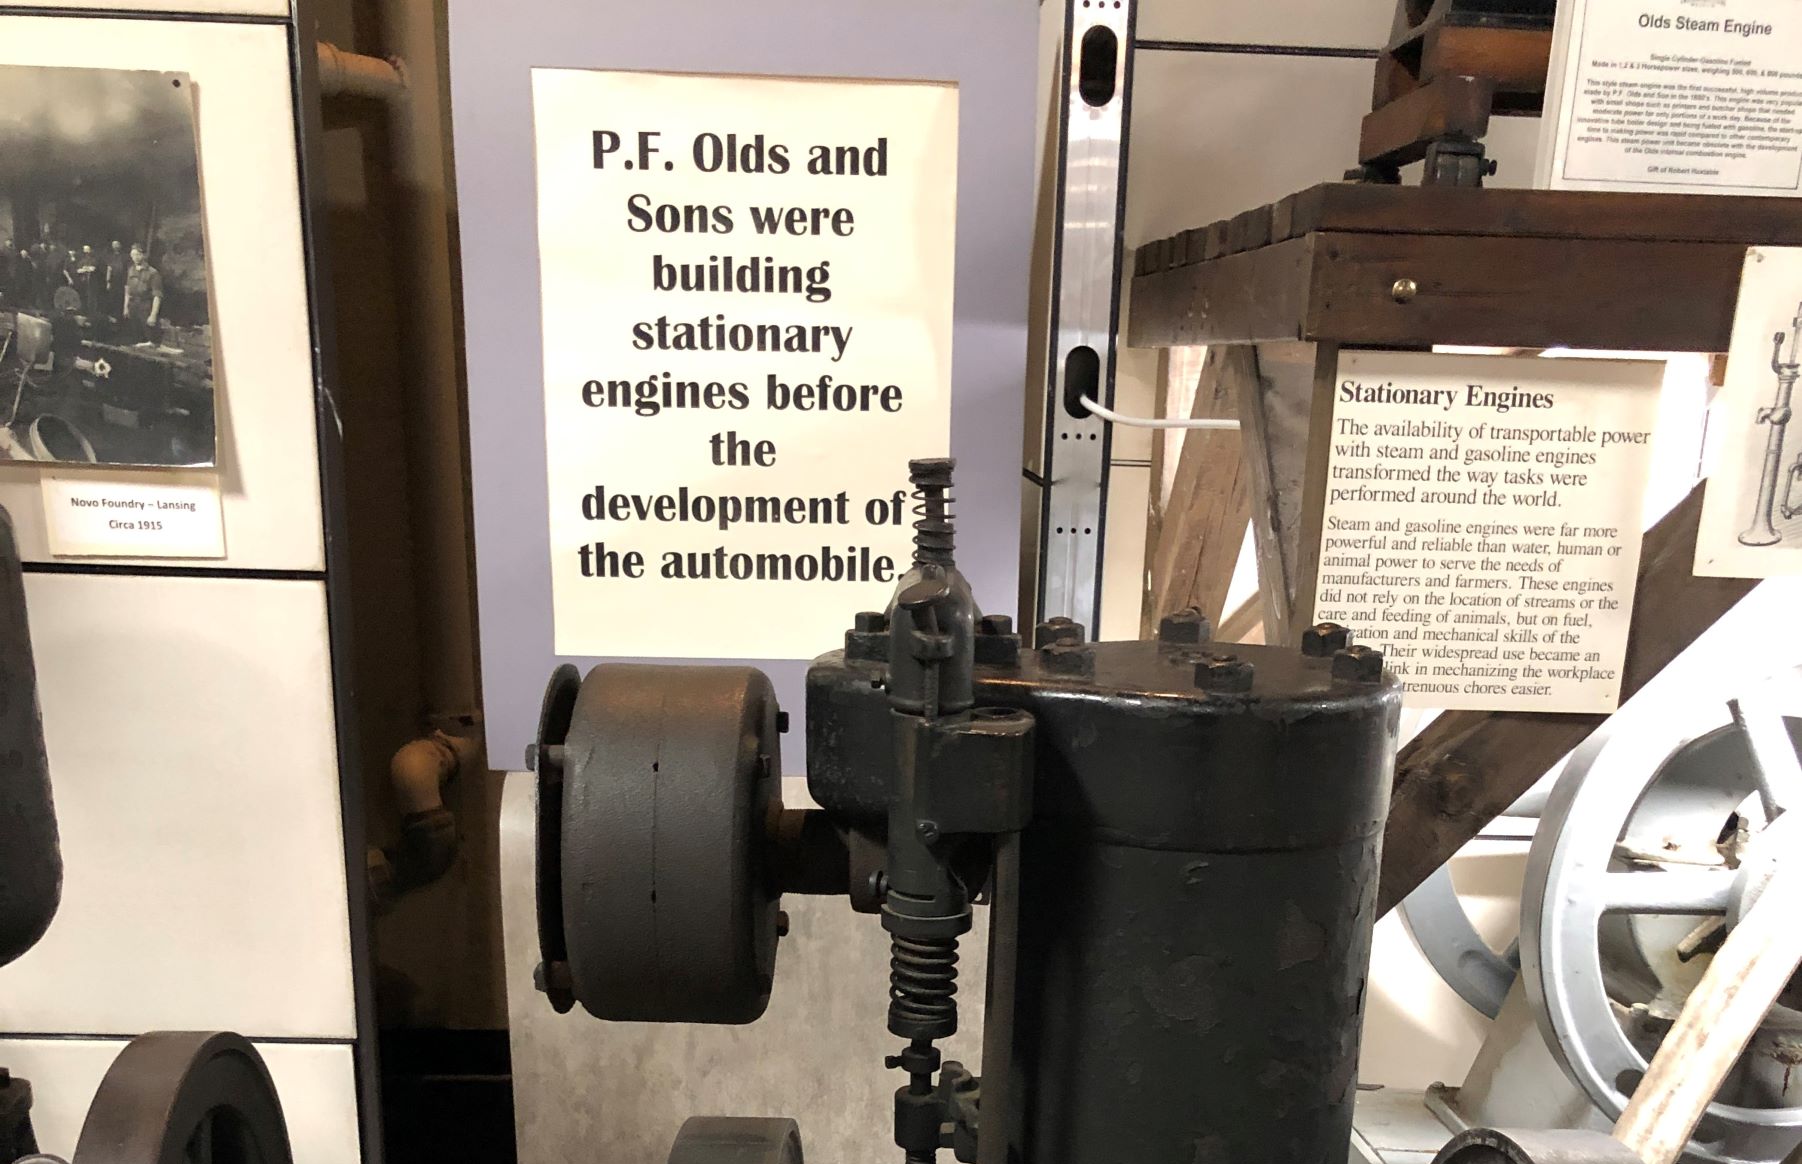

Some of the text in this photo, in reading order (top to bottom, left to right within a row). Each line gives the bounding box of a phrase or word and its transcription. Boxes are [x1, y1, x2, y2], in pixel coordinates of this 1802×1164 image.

[1638, 13, 1772, 37] Olds Steam Engine
[592, 130, 887, 175] P.F. Olds and
[627, 194, 854, 236] Sons were
[653, 255, 831, 302] building
[632, 315, 853, 360] stationary
[581, 372, 902, 416] engines before
[1339, 380, 1554, 412] Stationary Engines
[1337, 418, 1651, 447] The availability of transportable power
[708, 431, 776, 466] the
[1335, 440, 1596, 468] with steam and gasoline engines
[1332, 464, 1587, 488] transformed the way tasks were
[70, 497, 99, 507] Novo
[101, 498, 145, 510] Foundry
[156, 500, 196, 512] Lansing
[581, 486, 906, 529] development of
[1330, 485, 1561, 507] performed around the world.
[108, 519, 162, 530] Circa 1915
[1327, 515, 1618, 540] Steam and gasoline engines were far more
[1325, 535, 1622, 557] powerful and reliable than water, human or
[577, 542, 644, 578] the
[1323, 553, 1564, 572] animal power to serve the needs of
[1321, 571, 1613, 595] manufacturers and farmers. These engines
[1319, 588, 1618, 610] did not rely on the location of streams or the
[1317, 607, 1593, 629] care and feeding of animals, but on fuel,
[1392, 626, 1418, 640] and
[1422, 627, 1499, 641] mechanical
[1502, 629, 1538, 642] skills
[1542, 630, 1558, 643] of
[1559, 630, 1580, 644] the
[1380, 643, 1600, 662] Their widespread use became an
[1414, 661, 1427, 675] in
[1432, 662, 1518, 682] mechanizing
[1522, 664, 1542, 678] the
[1547, 665, 1615, 682] workplace
[1402, 680, 1553, 695] trenuous chores easier.
